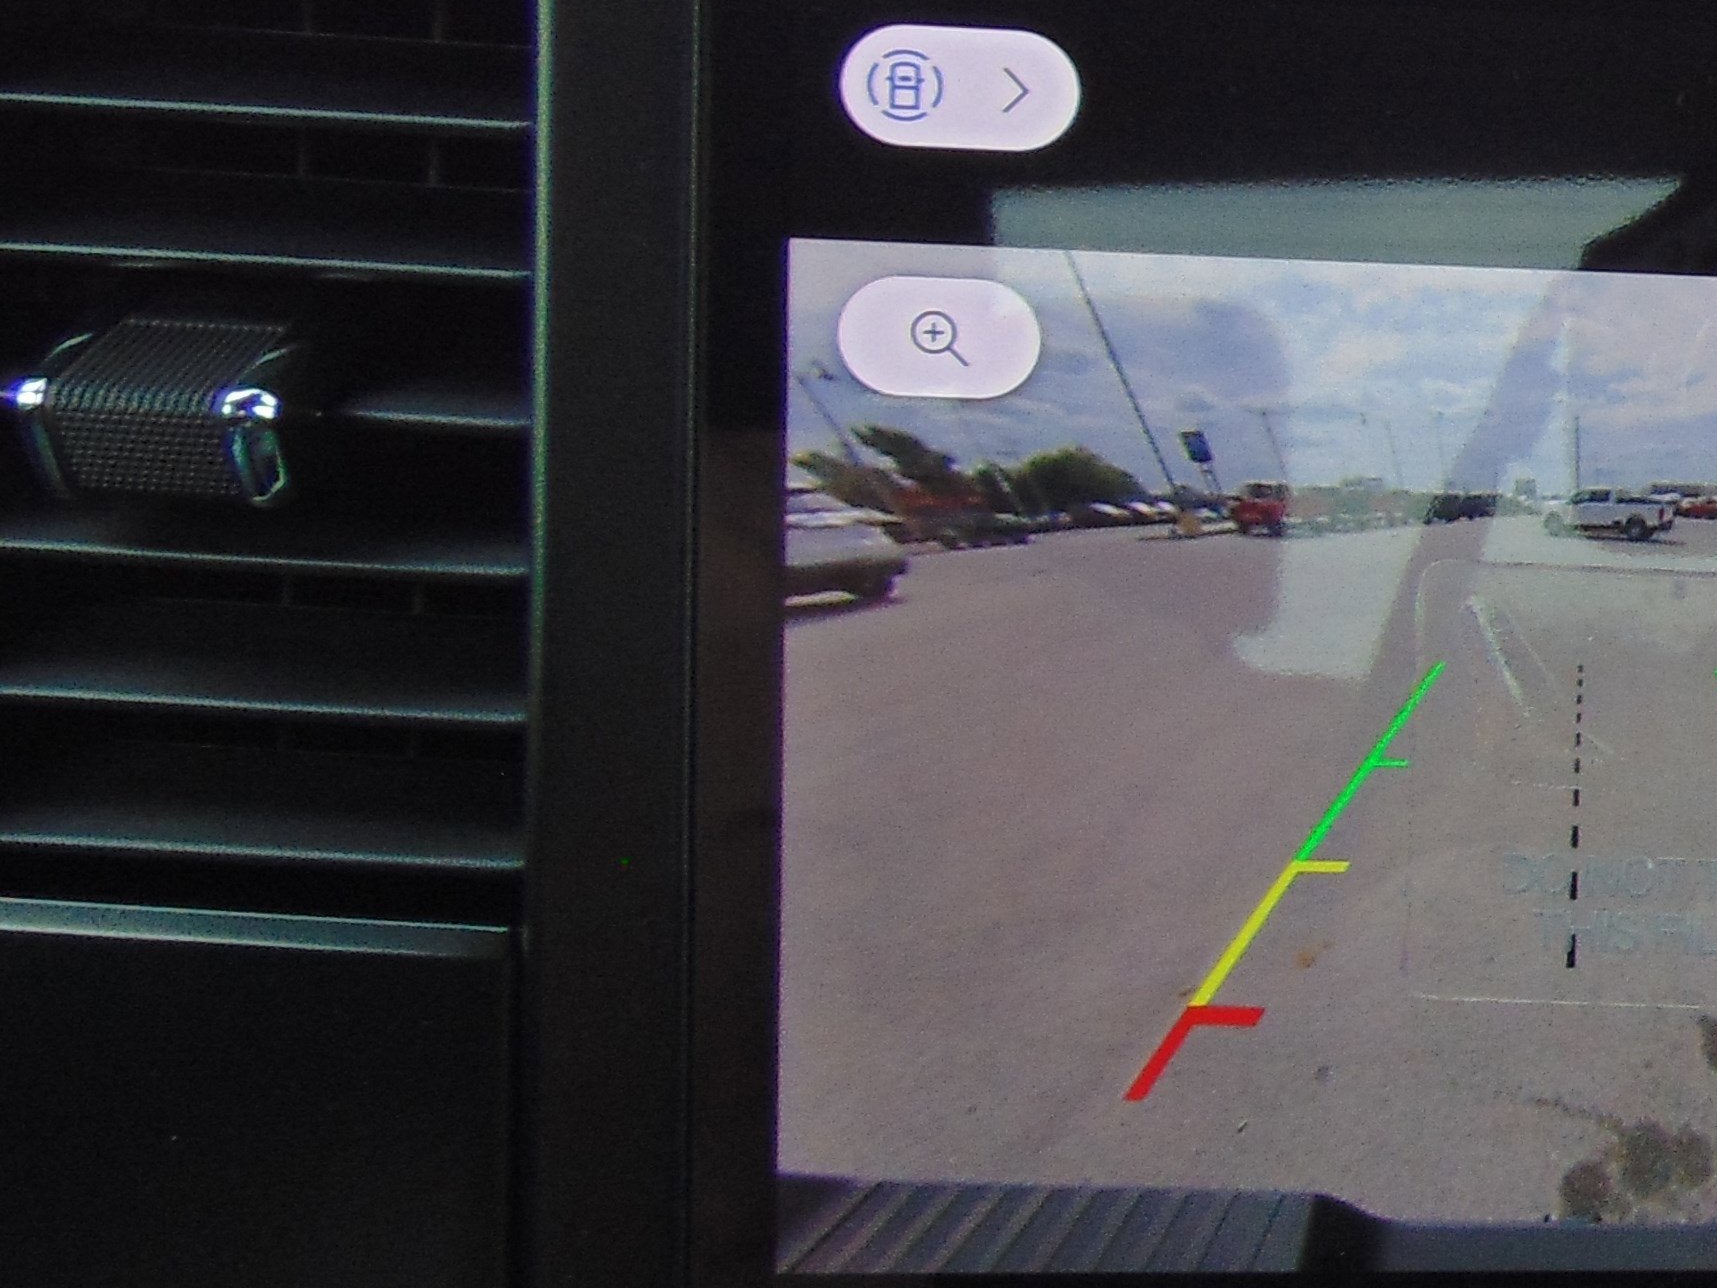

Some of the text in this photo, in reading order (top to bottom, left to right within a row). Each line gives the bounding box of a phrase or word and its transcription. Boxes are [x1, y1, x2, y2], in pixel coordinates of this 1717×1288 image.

[1500, 851, 1571, 896] DO
[1580, 852, 1688, 899] NOT
[1531, 907, 1642, 954] THIS
